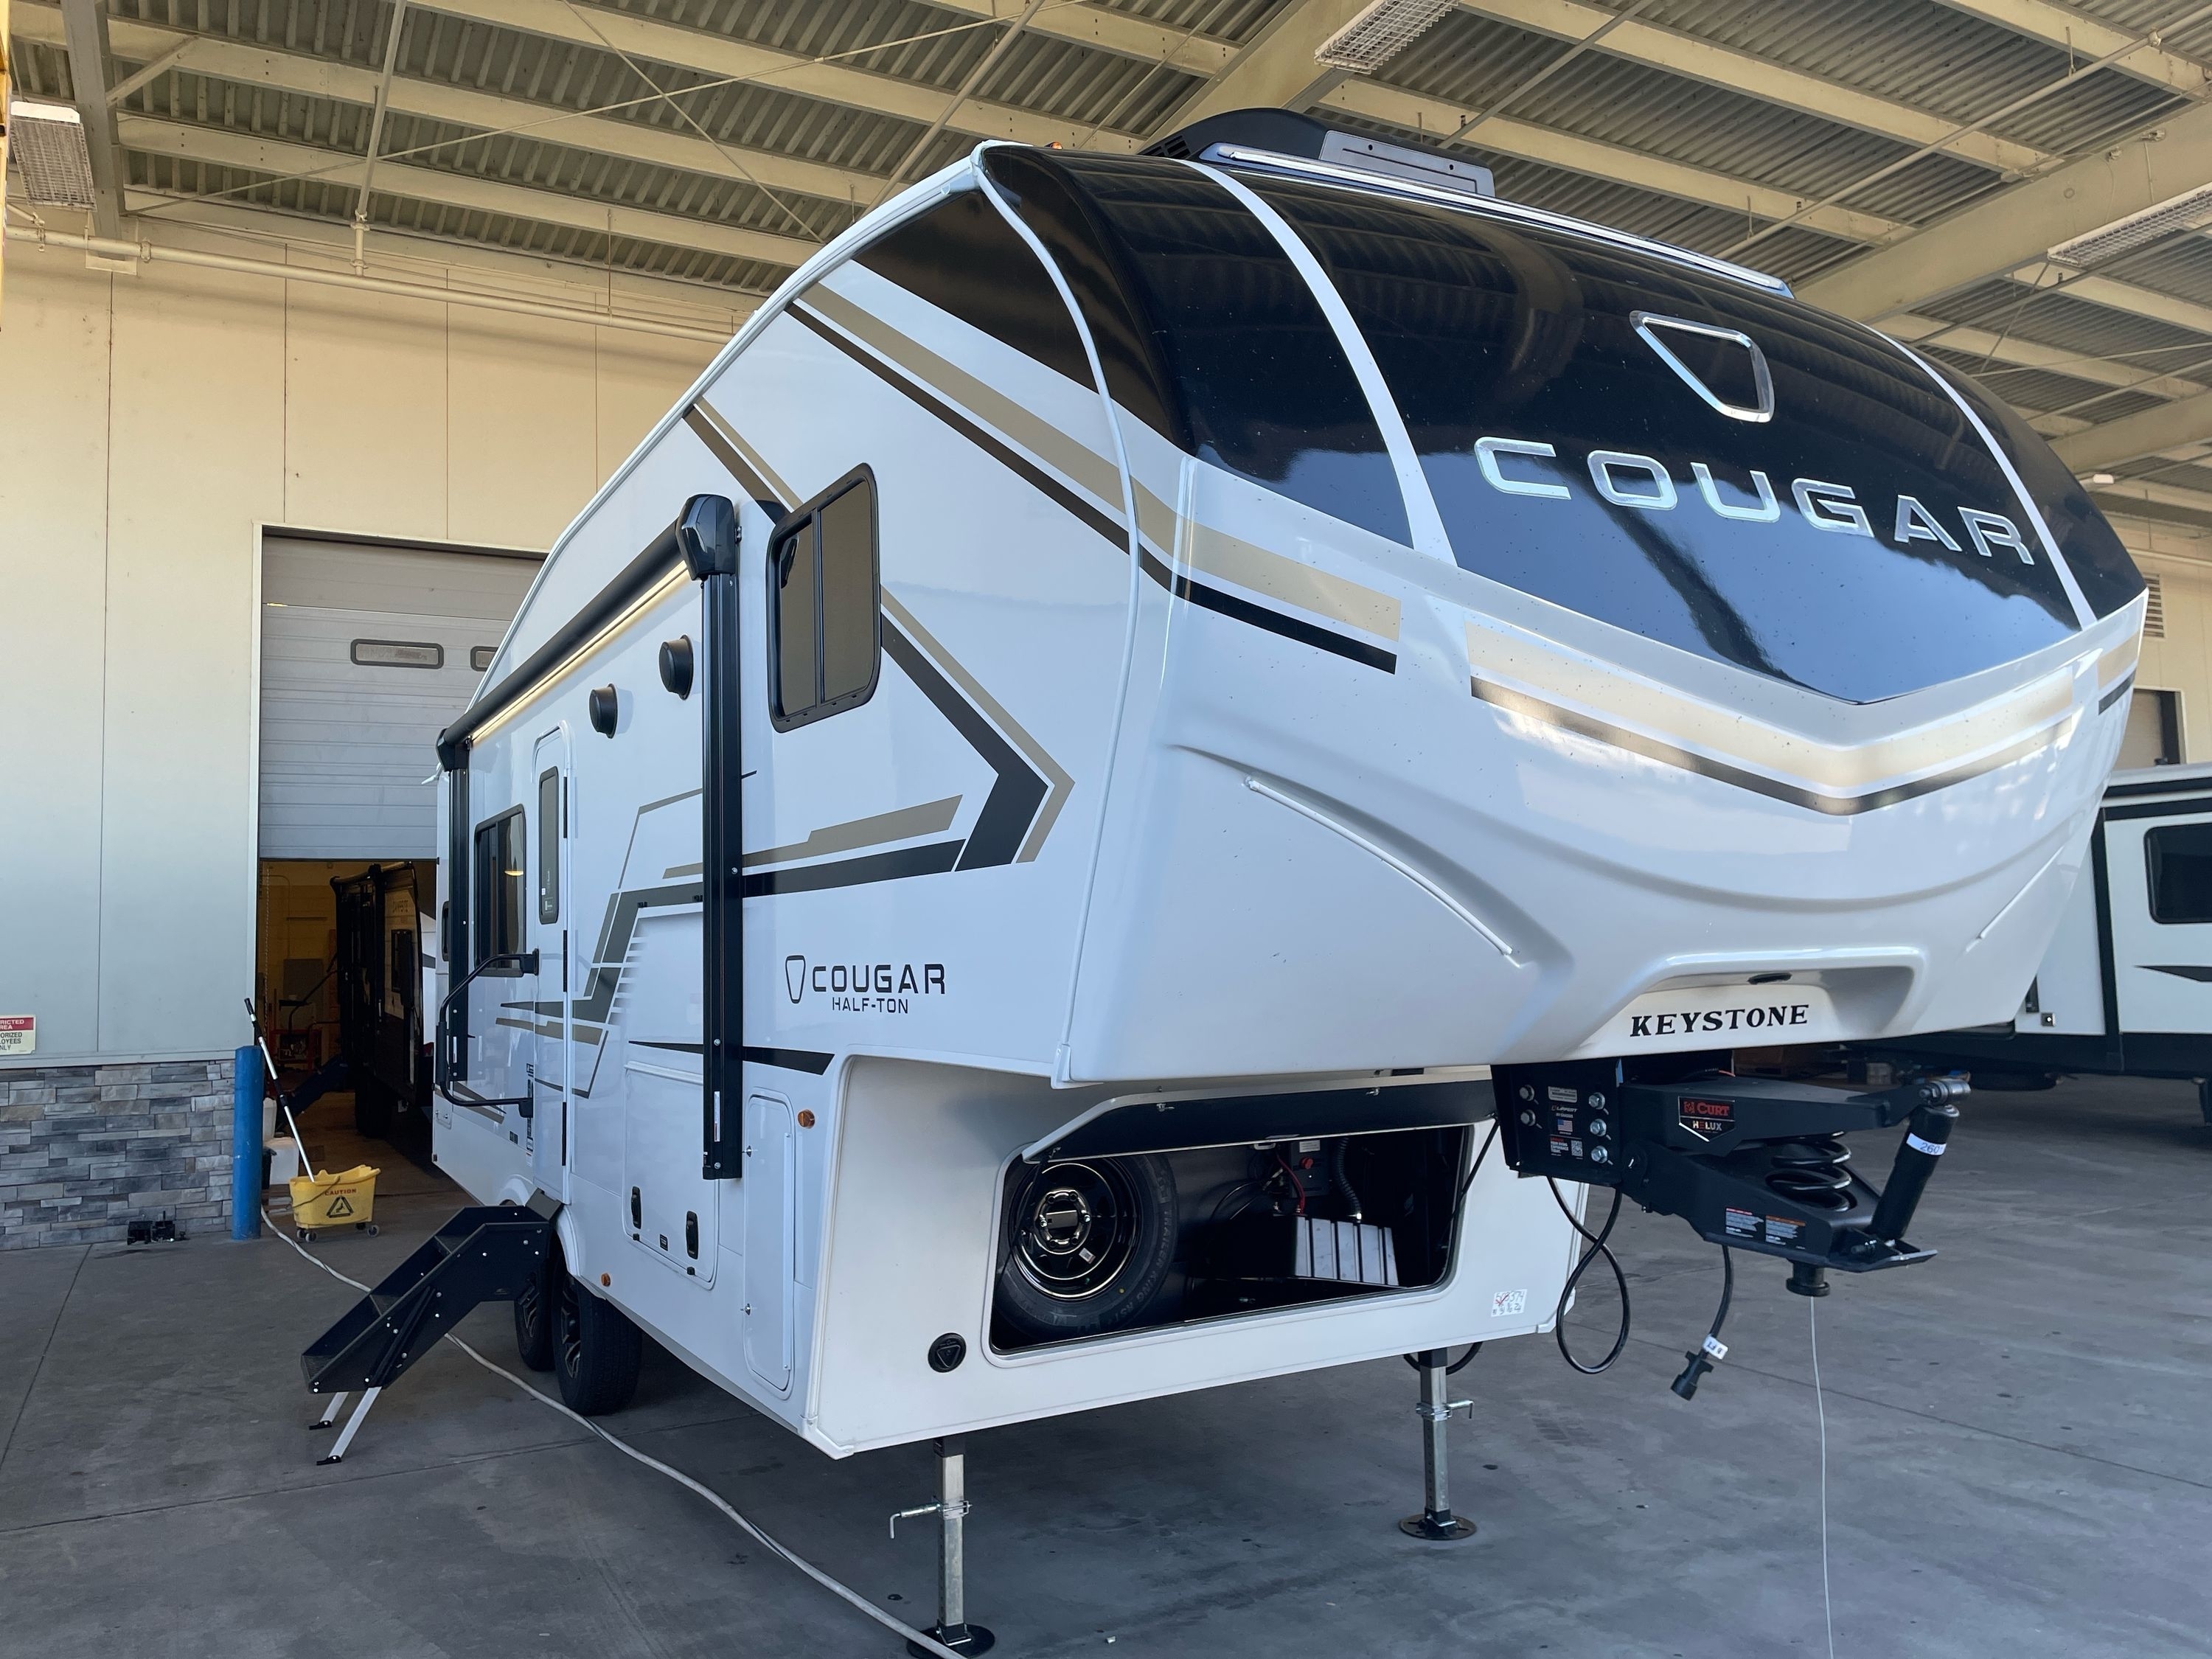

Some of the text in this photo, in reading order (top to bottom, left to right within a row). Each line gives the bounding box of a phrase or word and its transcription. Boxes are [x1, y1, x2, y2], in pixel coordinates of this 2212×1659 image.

[1475, 437, 2034, 566] COUGAR
[812, 964, 945, 994] COUGAR
[832, 997, 908, 1014] HALF-TON
[1630, 1004, 1809, 1037] KEYSTONE
[1697, 1102, 1730, 1116] CURT
[1692, 1121, 1722, 1131] HELUX
[1920, 1142, 1940, 1154] 260
[325, 1188, 357, 1196] CAUTION
